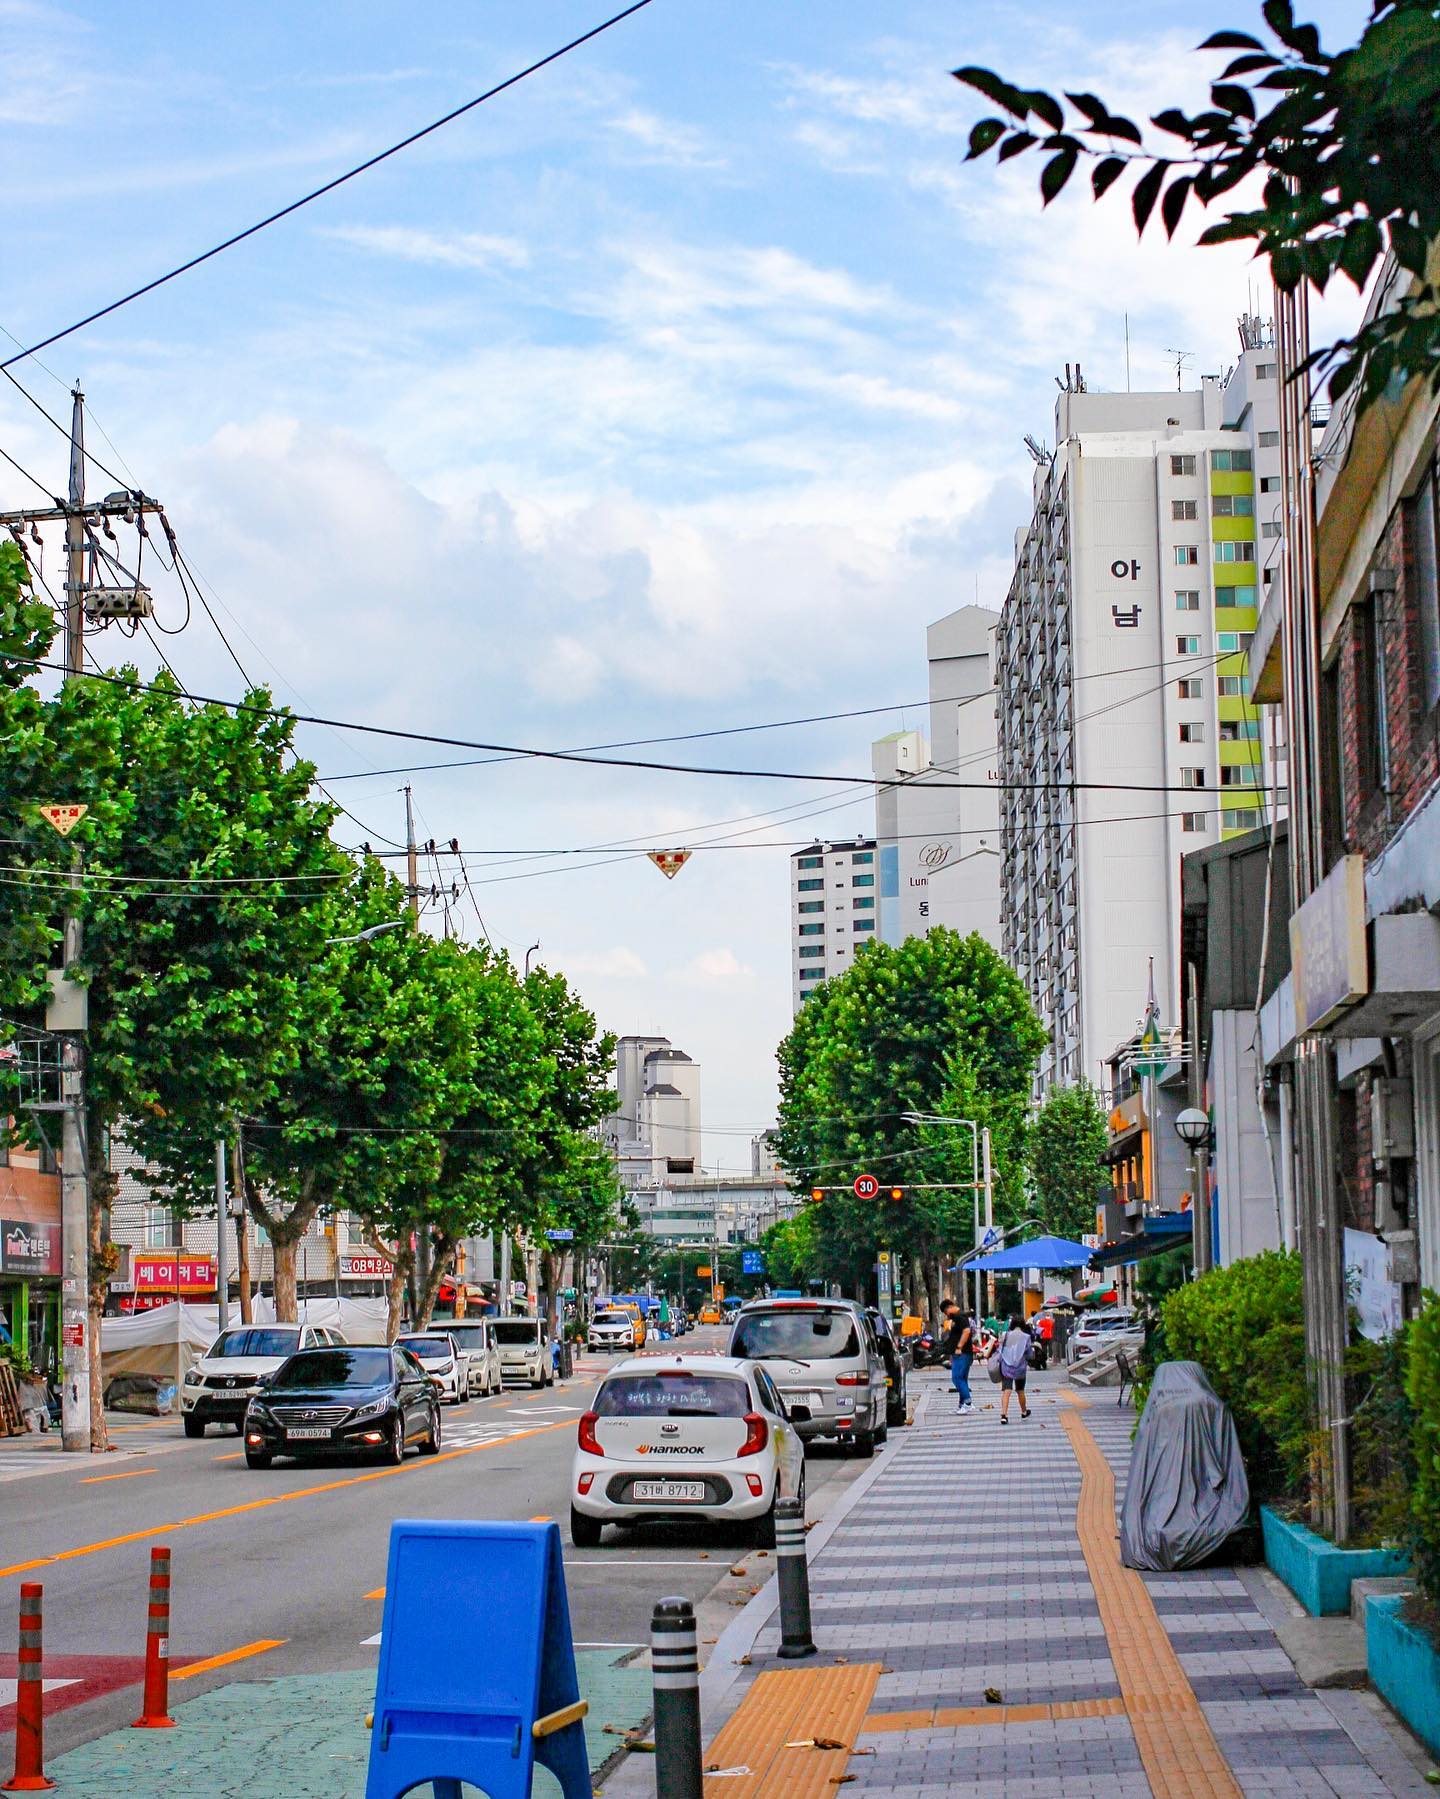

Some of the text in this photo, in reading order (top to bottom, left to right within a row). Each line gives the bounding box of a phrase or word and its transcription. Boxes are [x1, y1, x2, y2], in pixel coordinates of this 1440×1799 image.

[1111, 559, 1142, 627] 아남
[910, 877, 929, 887] Lun
[859, 1181, 873, 1193] 30
[140, 1265, 209, 1282] 베이커리
[308, 1429, 327, 1437] 0574
[641, 1482, 697, 1496] 31버 8712
